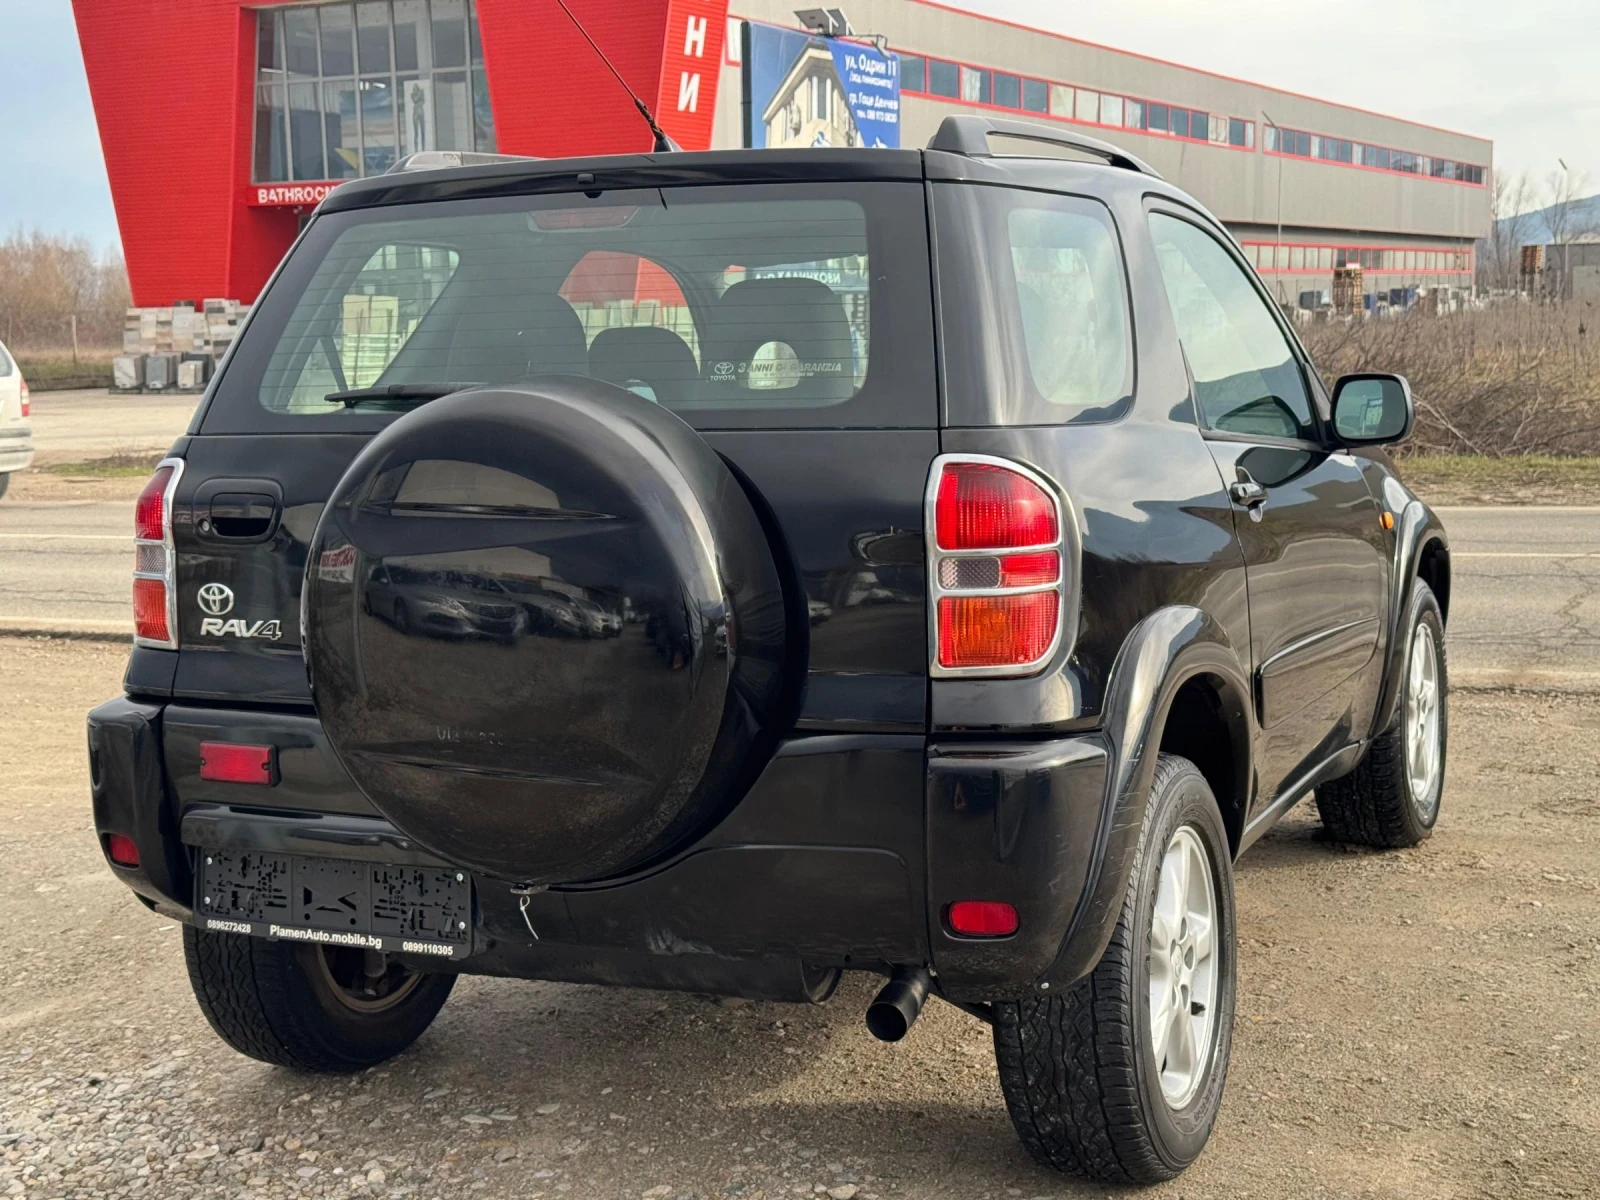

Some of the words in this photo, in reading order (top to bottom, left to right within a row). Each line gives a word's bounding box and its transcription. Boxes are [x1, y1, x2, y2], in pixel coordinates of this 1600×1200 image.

[845, 54, 857, 71] ул.
[858, 53, 886, 75] Одрин
[887, 60, 897, 77] 11
[858, 91, 874, 107] Гоце
[874, 95, 898, 110] Делчев
[737, 362, 747, 373] 3
[747, 363, 773, 373] ANNI
[789, 362, 842, 373] GARANZIA
[200, 618, 283, 641] RAV4
[207, 919, 251, 934] 0896272428
[269, 925, 383, 949] PlamenAuto.mobile.bg
[402, 941, 454, 956] 0899110305
